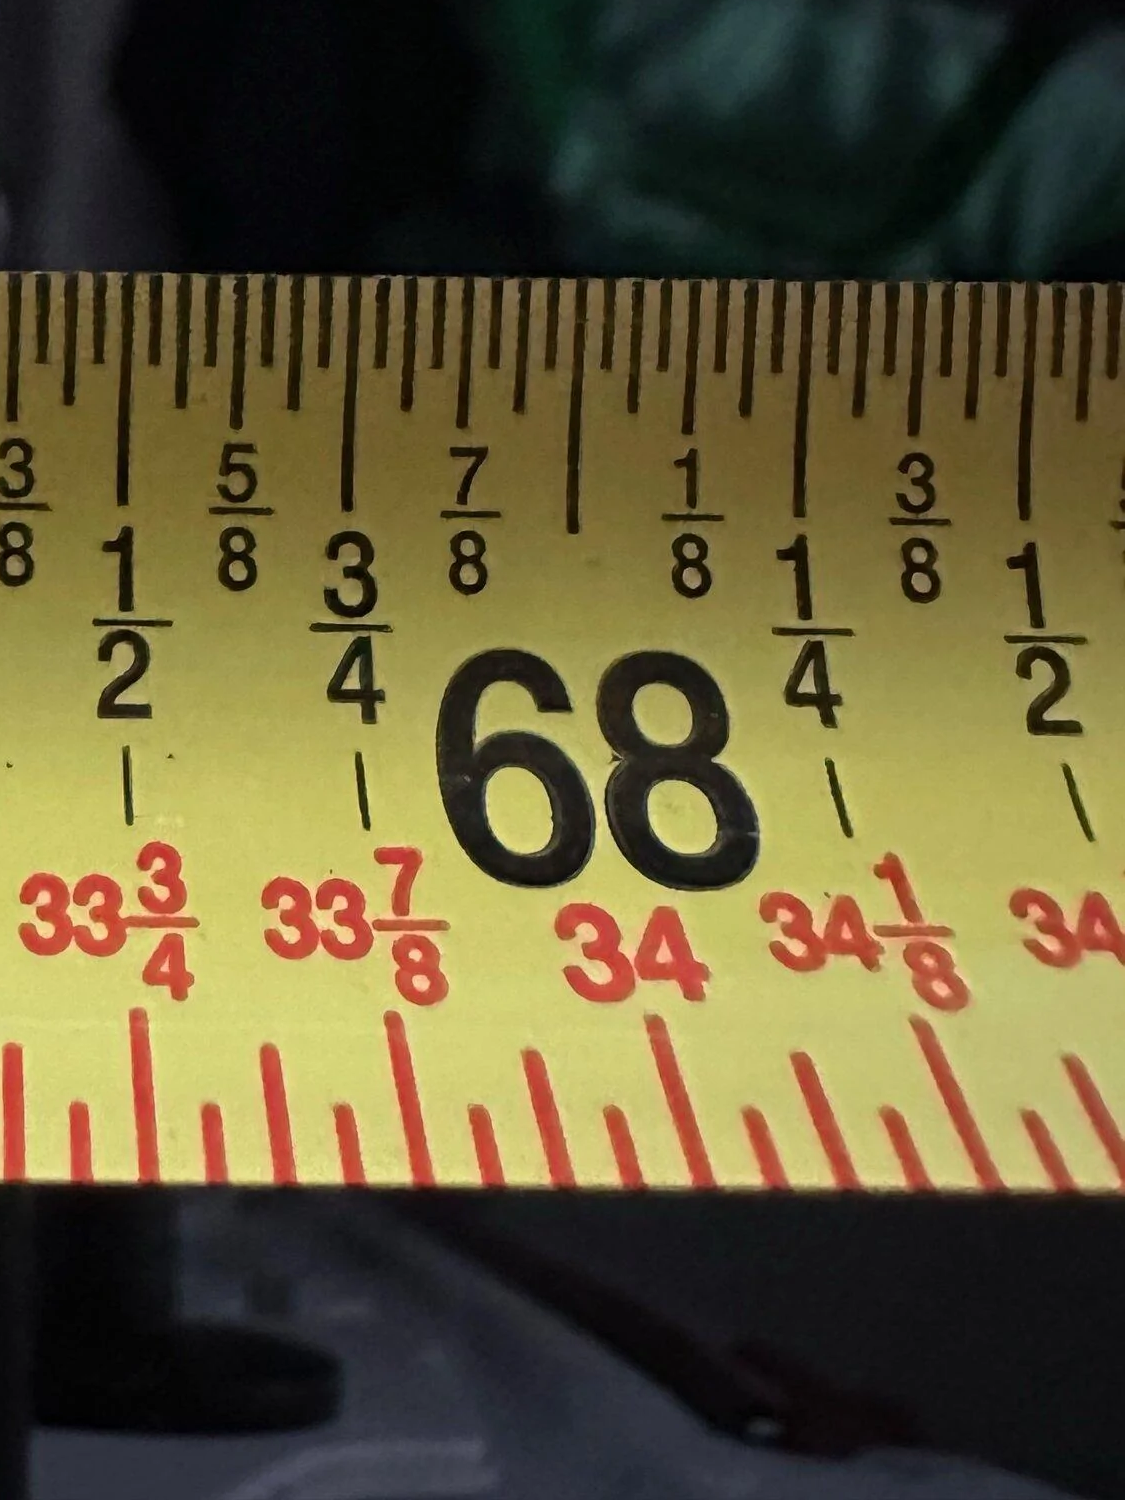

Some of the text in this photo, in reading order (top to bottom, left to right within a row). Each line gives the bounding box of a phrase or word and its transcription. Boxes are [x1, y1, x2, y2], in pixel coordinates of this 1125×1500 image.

[436, 650, 759, 891] 68
[20, 872, 125, 956] 33
[261, 877, 373, 960] 33
[554, 903, 707, 1003] 34
[759, 892, 881, 971] 34
